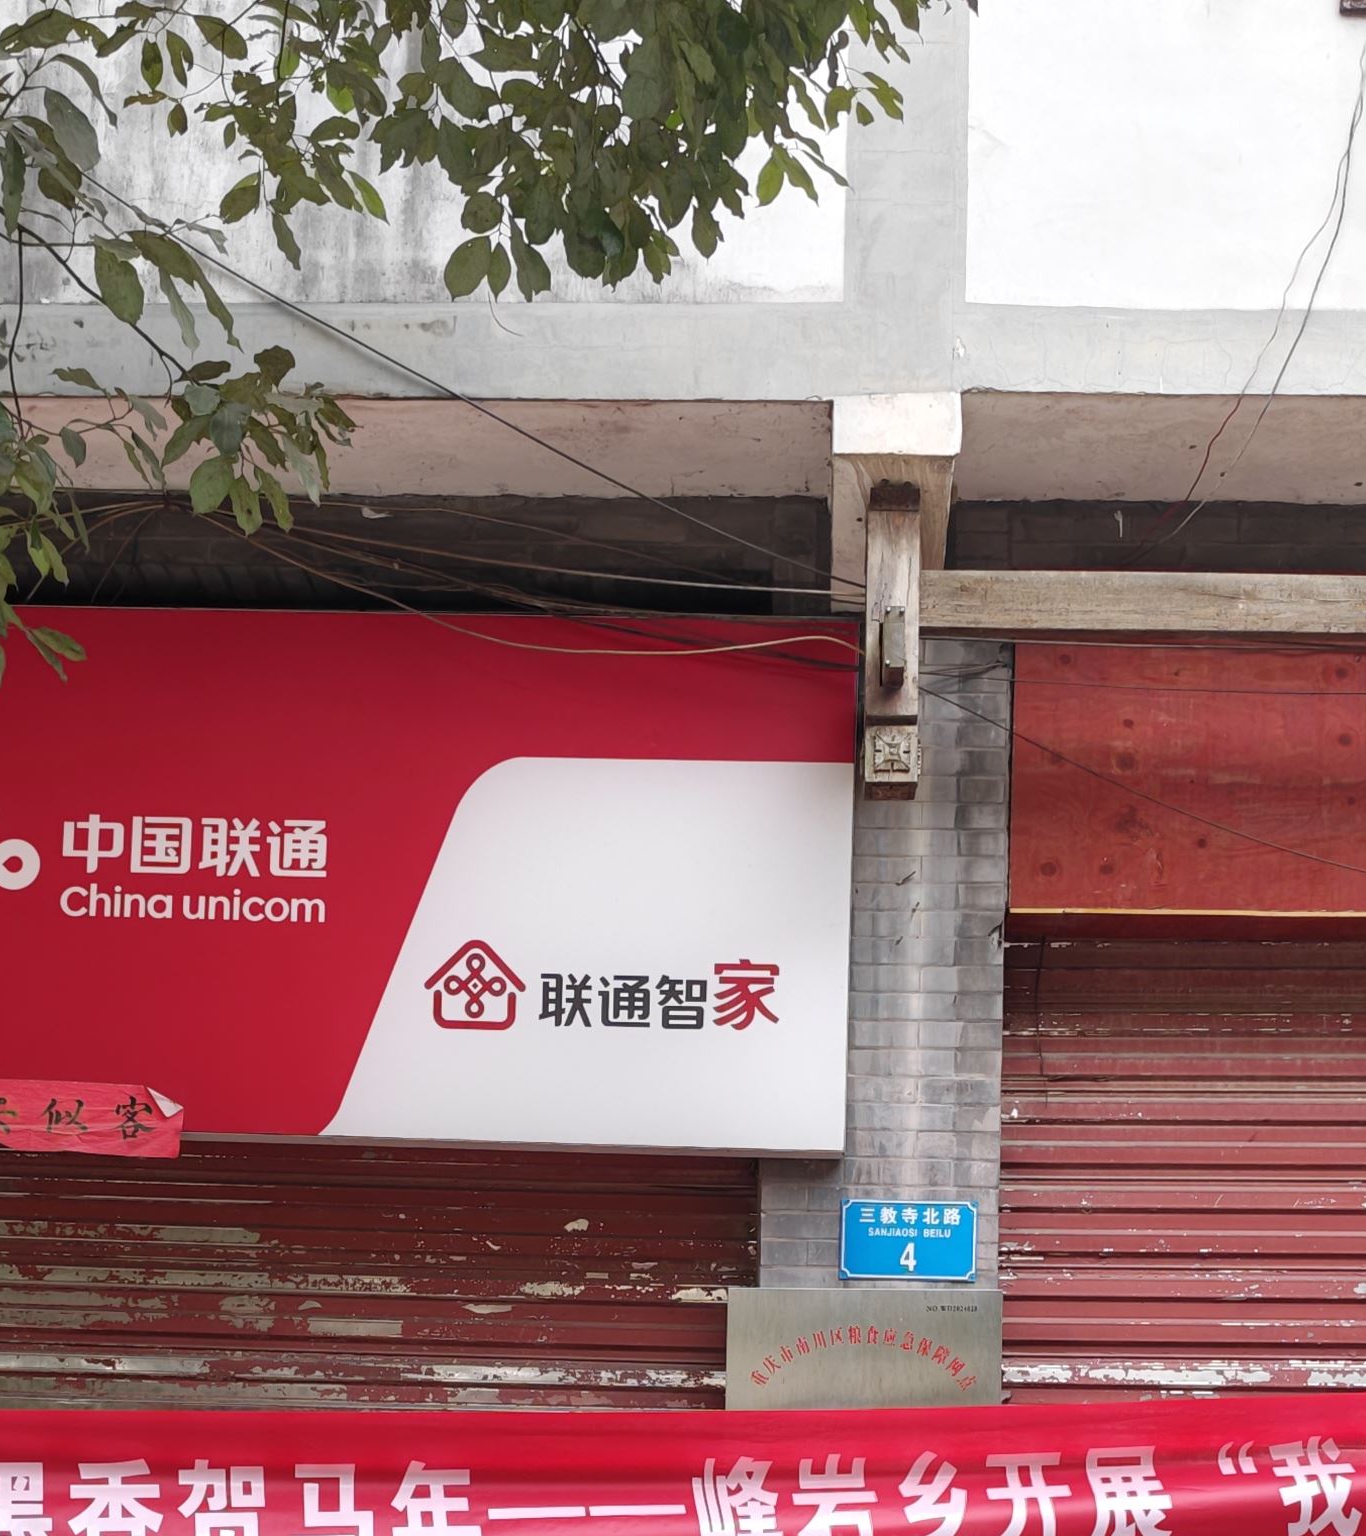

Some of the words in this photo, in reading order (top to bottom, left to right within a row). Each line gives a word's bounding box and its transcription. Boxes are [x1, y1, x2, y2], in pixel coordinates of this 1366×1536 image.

[60, 814, 328, 877] 中国联通
[59, 883, 173, 922] China
[182, 885, 326, 924] unicom
[538, 958, 781, 1031] 联通智家
[858, 1206, 961, 1226] 三教寺北路
[867, 1227, 918, 1238] SANJIAOSI
[923, 1228, 951, 1239] BEILU
[899, 1242, 917, 1272] 4
